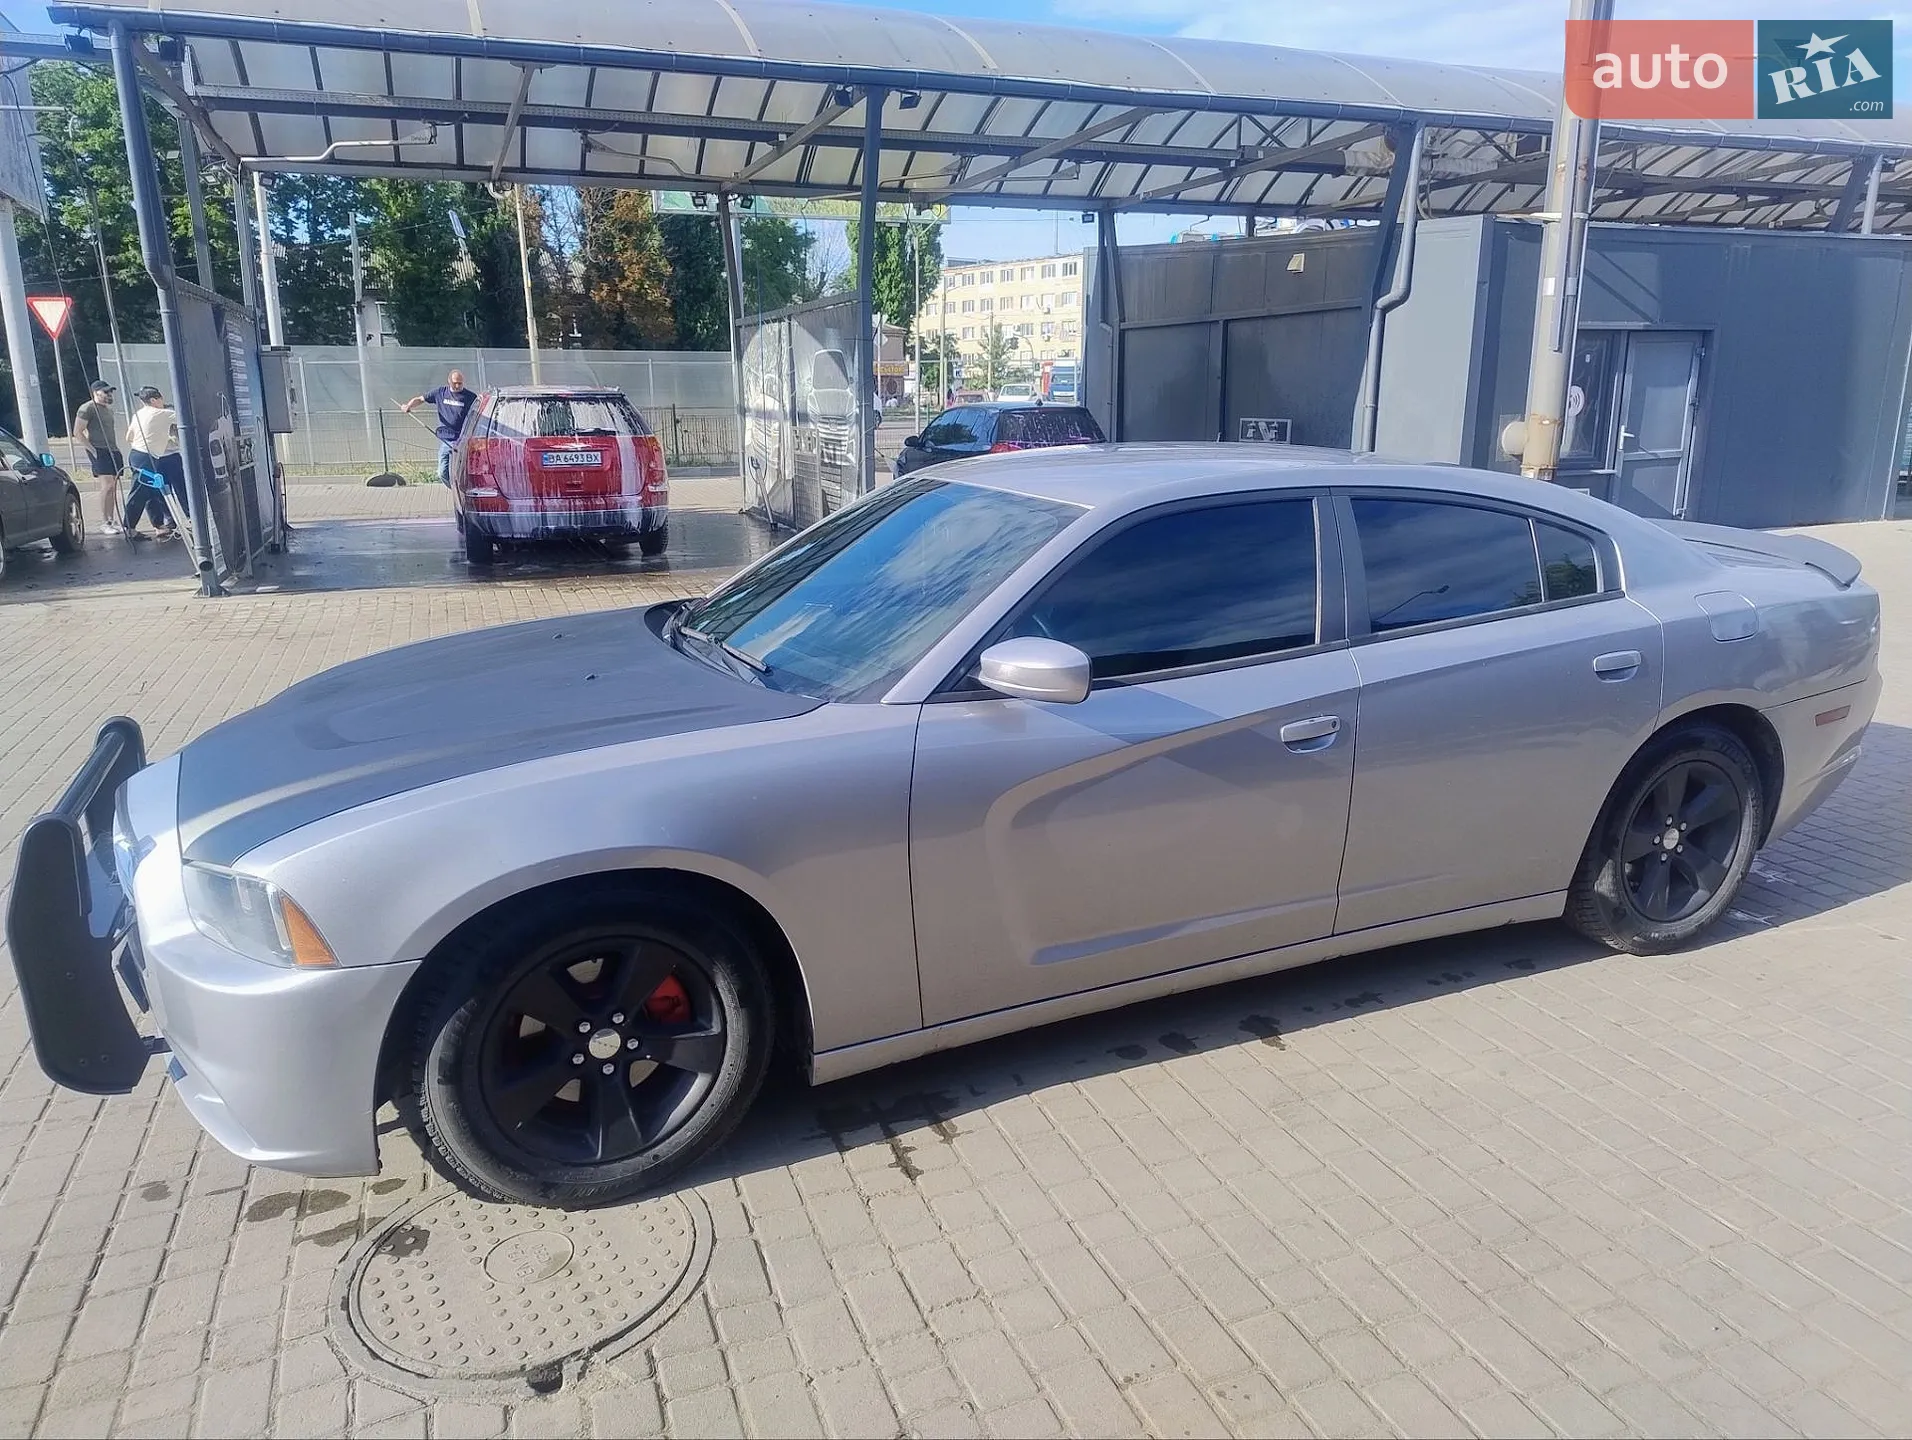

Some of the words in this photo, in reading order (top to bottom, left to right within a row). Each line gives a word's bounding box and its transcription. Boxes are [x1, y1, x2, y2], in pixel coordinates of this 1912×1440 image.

[548, 454, 561, 463] BA
[563, 454, 585, 463] 6493
[586, 453, 599, 462] BX
